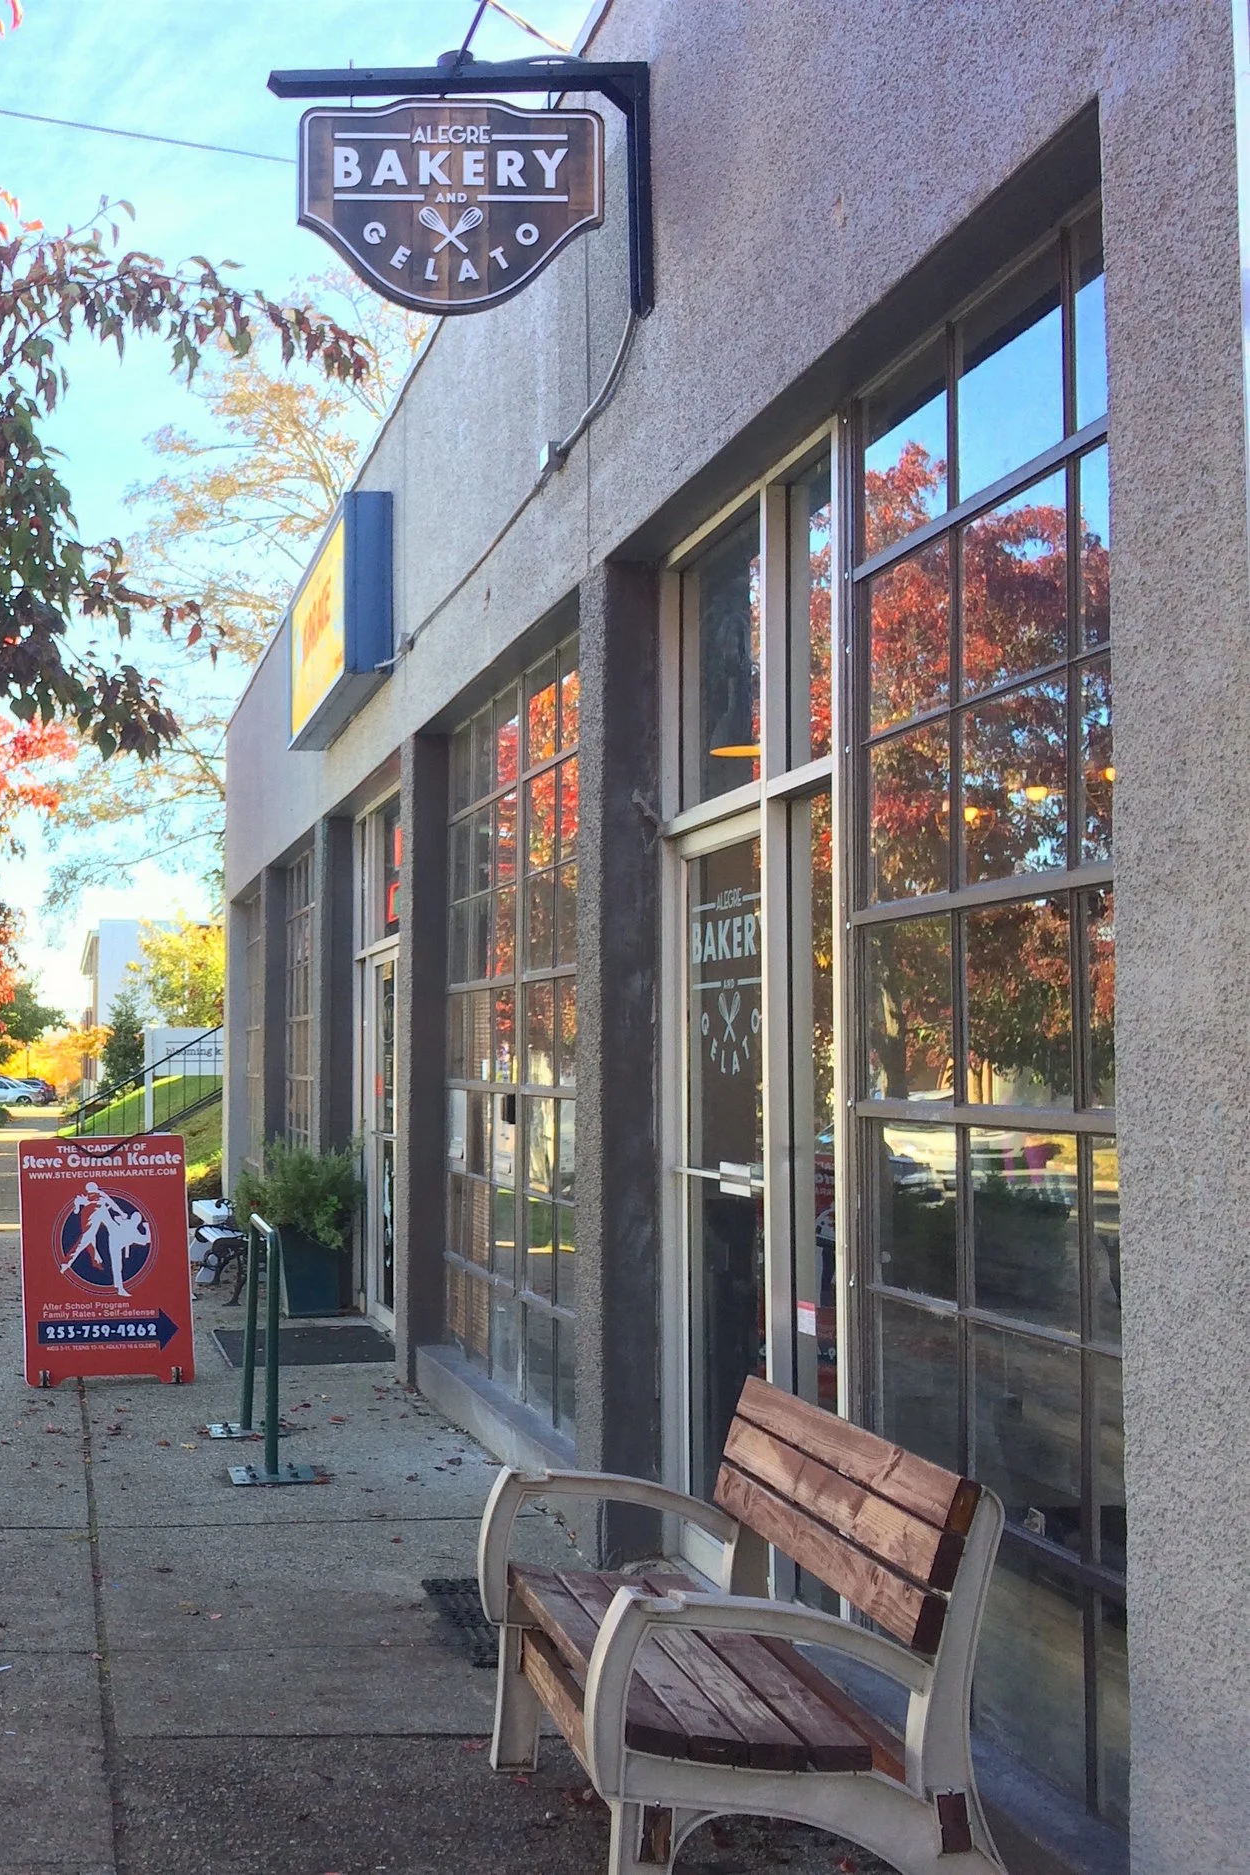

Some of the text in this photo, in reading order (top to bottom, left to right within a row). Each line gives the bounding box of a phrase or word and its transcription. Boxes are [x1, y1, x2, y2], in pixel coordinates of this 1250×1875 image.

[412, 125, 491, 145] ALEGRE
[333, 146, 569, 188] BAKERY
[435, 191, 468, 204] AND
[362, 221, 539, 282] GELATO
[716, 888, 742, 911] ALEGRE
[724, 978, 735, 990] AND
[701, 1008, 760, 1075] GELATO
[56, 1145, 78, 1153] THE
[133, 1143, 147, 1151] OF
[22, 1151, 182, 1169] Steve Curran Karate
[28, 1168, 177, 1180] WWW.STEVECURRANKARATE.COM
[65, 1302, 93, 1310] School
[95, 1301, 130, 1310] Program
[43, 1309, 155, 1319] Family Rates Self-defense
[46, 1323, 157, 1339] 253-759-4262
